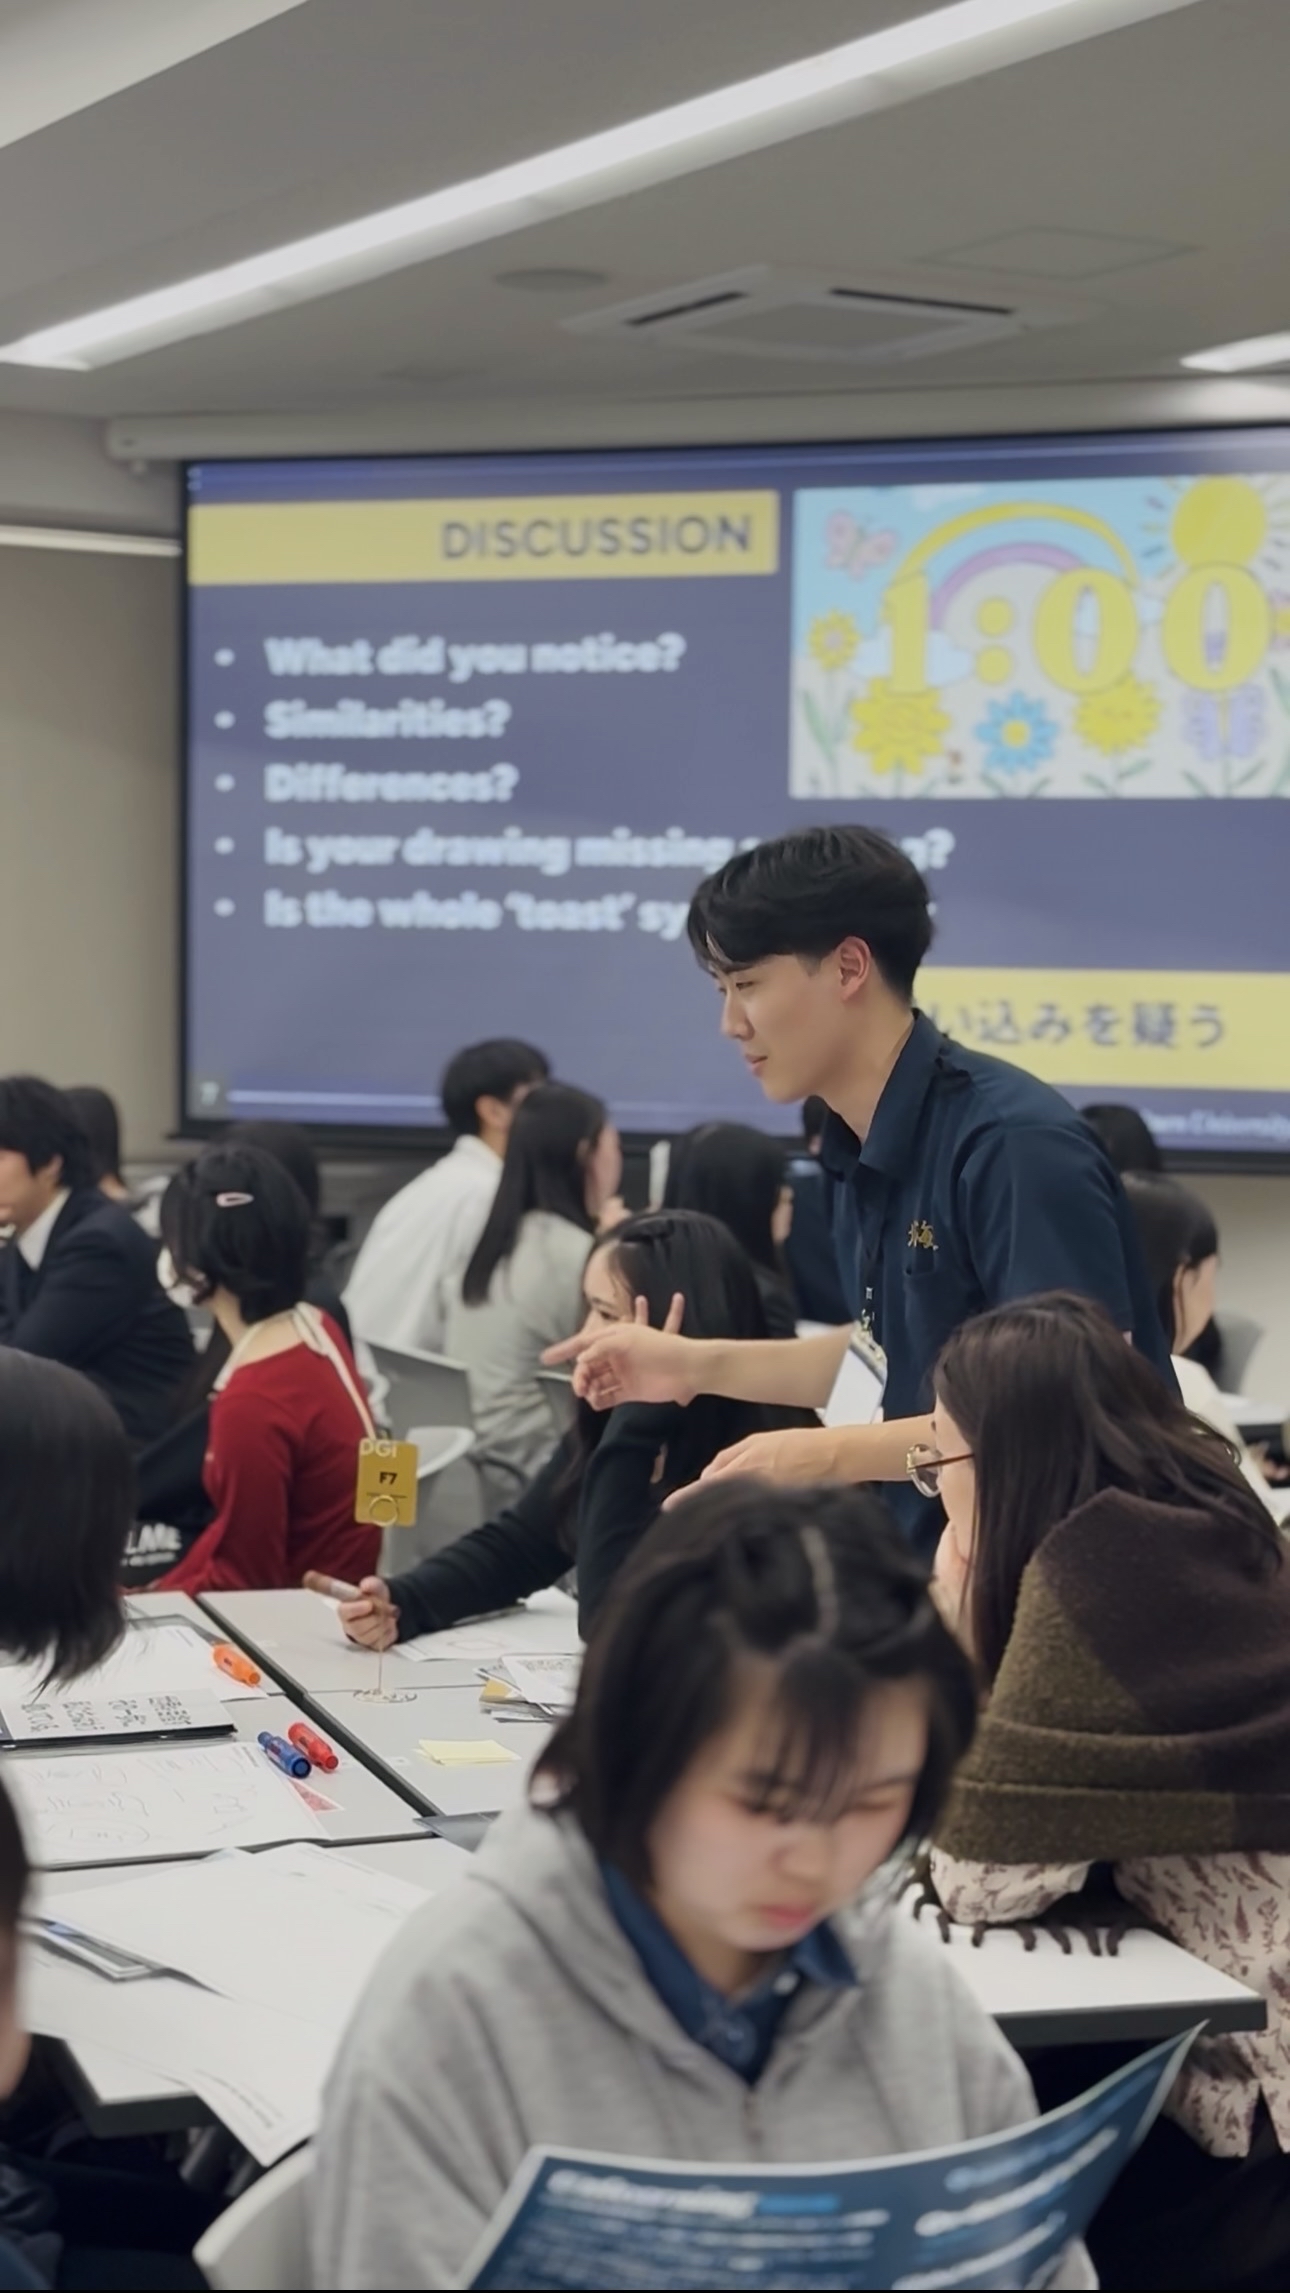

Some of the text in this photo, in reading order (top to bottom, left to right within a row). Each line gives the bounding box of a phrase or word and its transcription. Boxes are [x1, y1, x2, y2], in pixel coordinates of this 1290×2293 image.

[440, 513, 754, 562] DISCUSSION
[881, 564, 1272, 697] 1:00
[264, 632, 687, 684] What did you notice?
[264, 697, 512, 738] Similarities?
[264, 762, 520, 802] Differences?
[264, 826, 303, 865] Is
[304, 834, 399, 874] your
[402, 826, 571, 876] drawing
[575, 825, 735, 876] missing
[264, 889, 303, 928] Is
[304, 889, 375, 928] the
[377, 890, 503, 930] whole
[379, 1471, 398, 1486] F7
